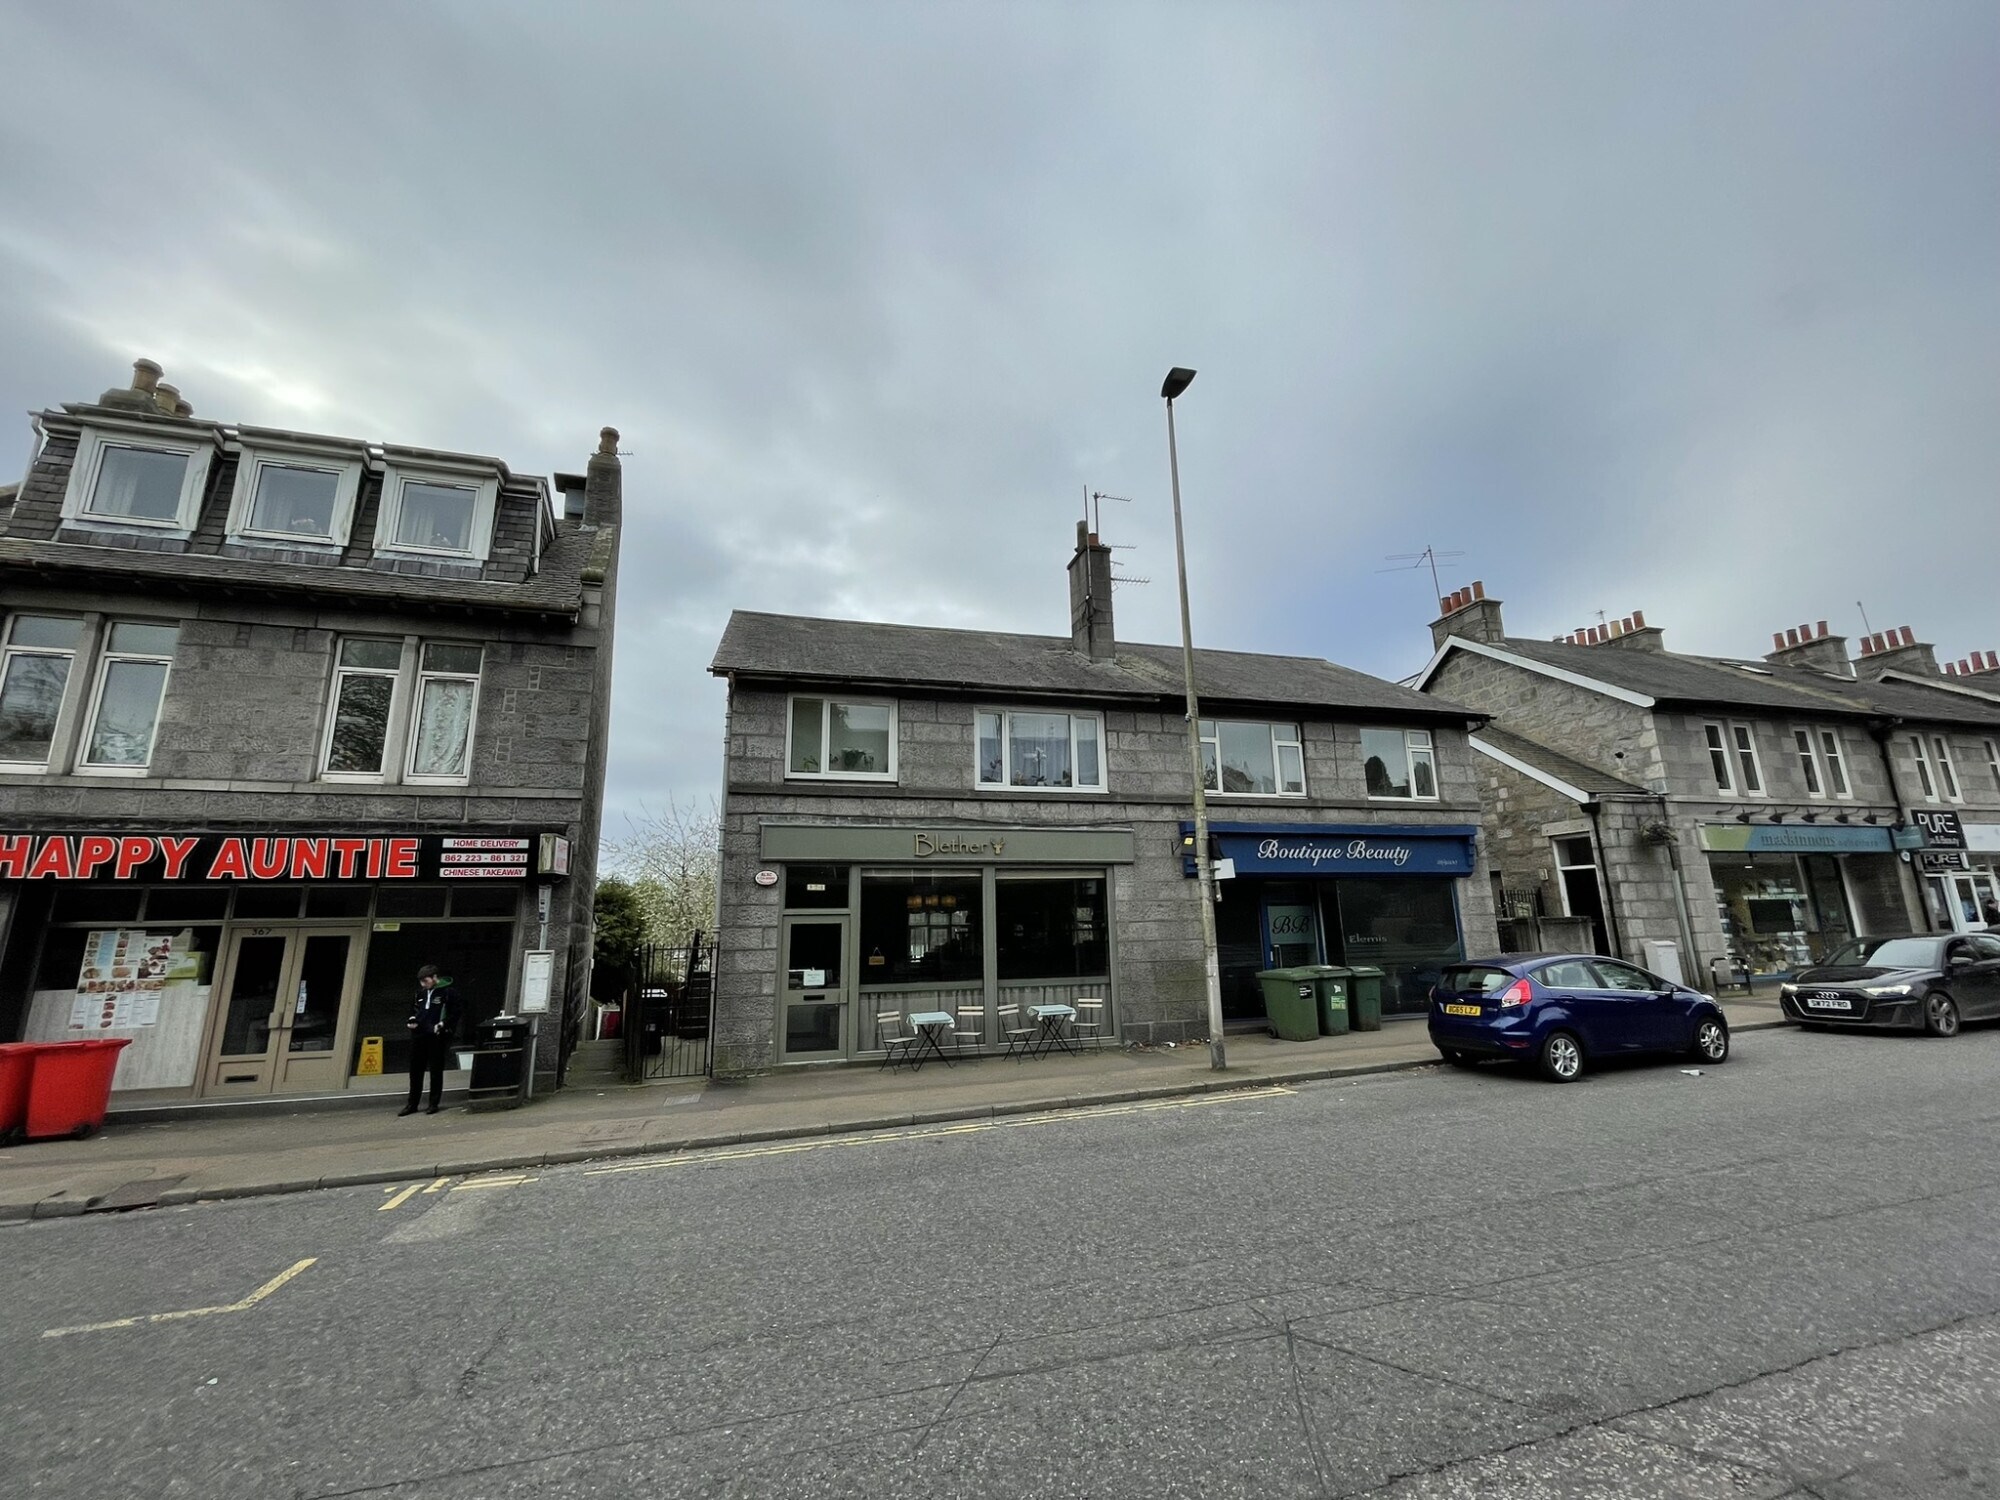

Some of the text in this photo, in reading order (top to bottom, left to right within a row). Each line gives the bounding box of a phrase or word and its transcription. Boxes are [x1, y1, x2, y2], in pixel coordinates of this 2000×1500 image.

[1917, 813, 1957, 833] PURE
[453, 839, 519, 848] HOME DELIVERY
[914, 832, 988, 857] Blether
[0, 835, 421, 879] HAPPY AUNTIE
[1257, 838, 1412, 866] Boutique Beauty
[444, 854, 462, 862] 862
[465, 854, 482, 862] 223
[490, 854, 506, 862] 861
[510, 854, 525, 862] 321
[1924, 853, 1960, 864] PURE
[442, 868, 524, 877] CHINESE TAKEAWAY
[251, 928, 272, 936] 367
